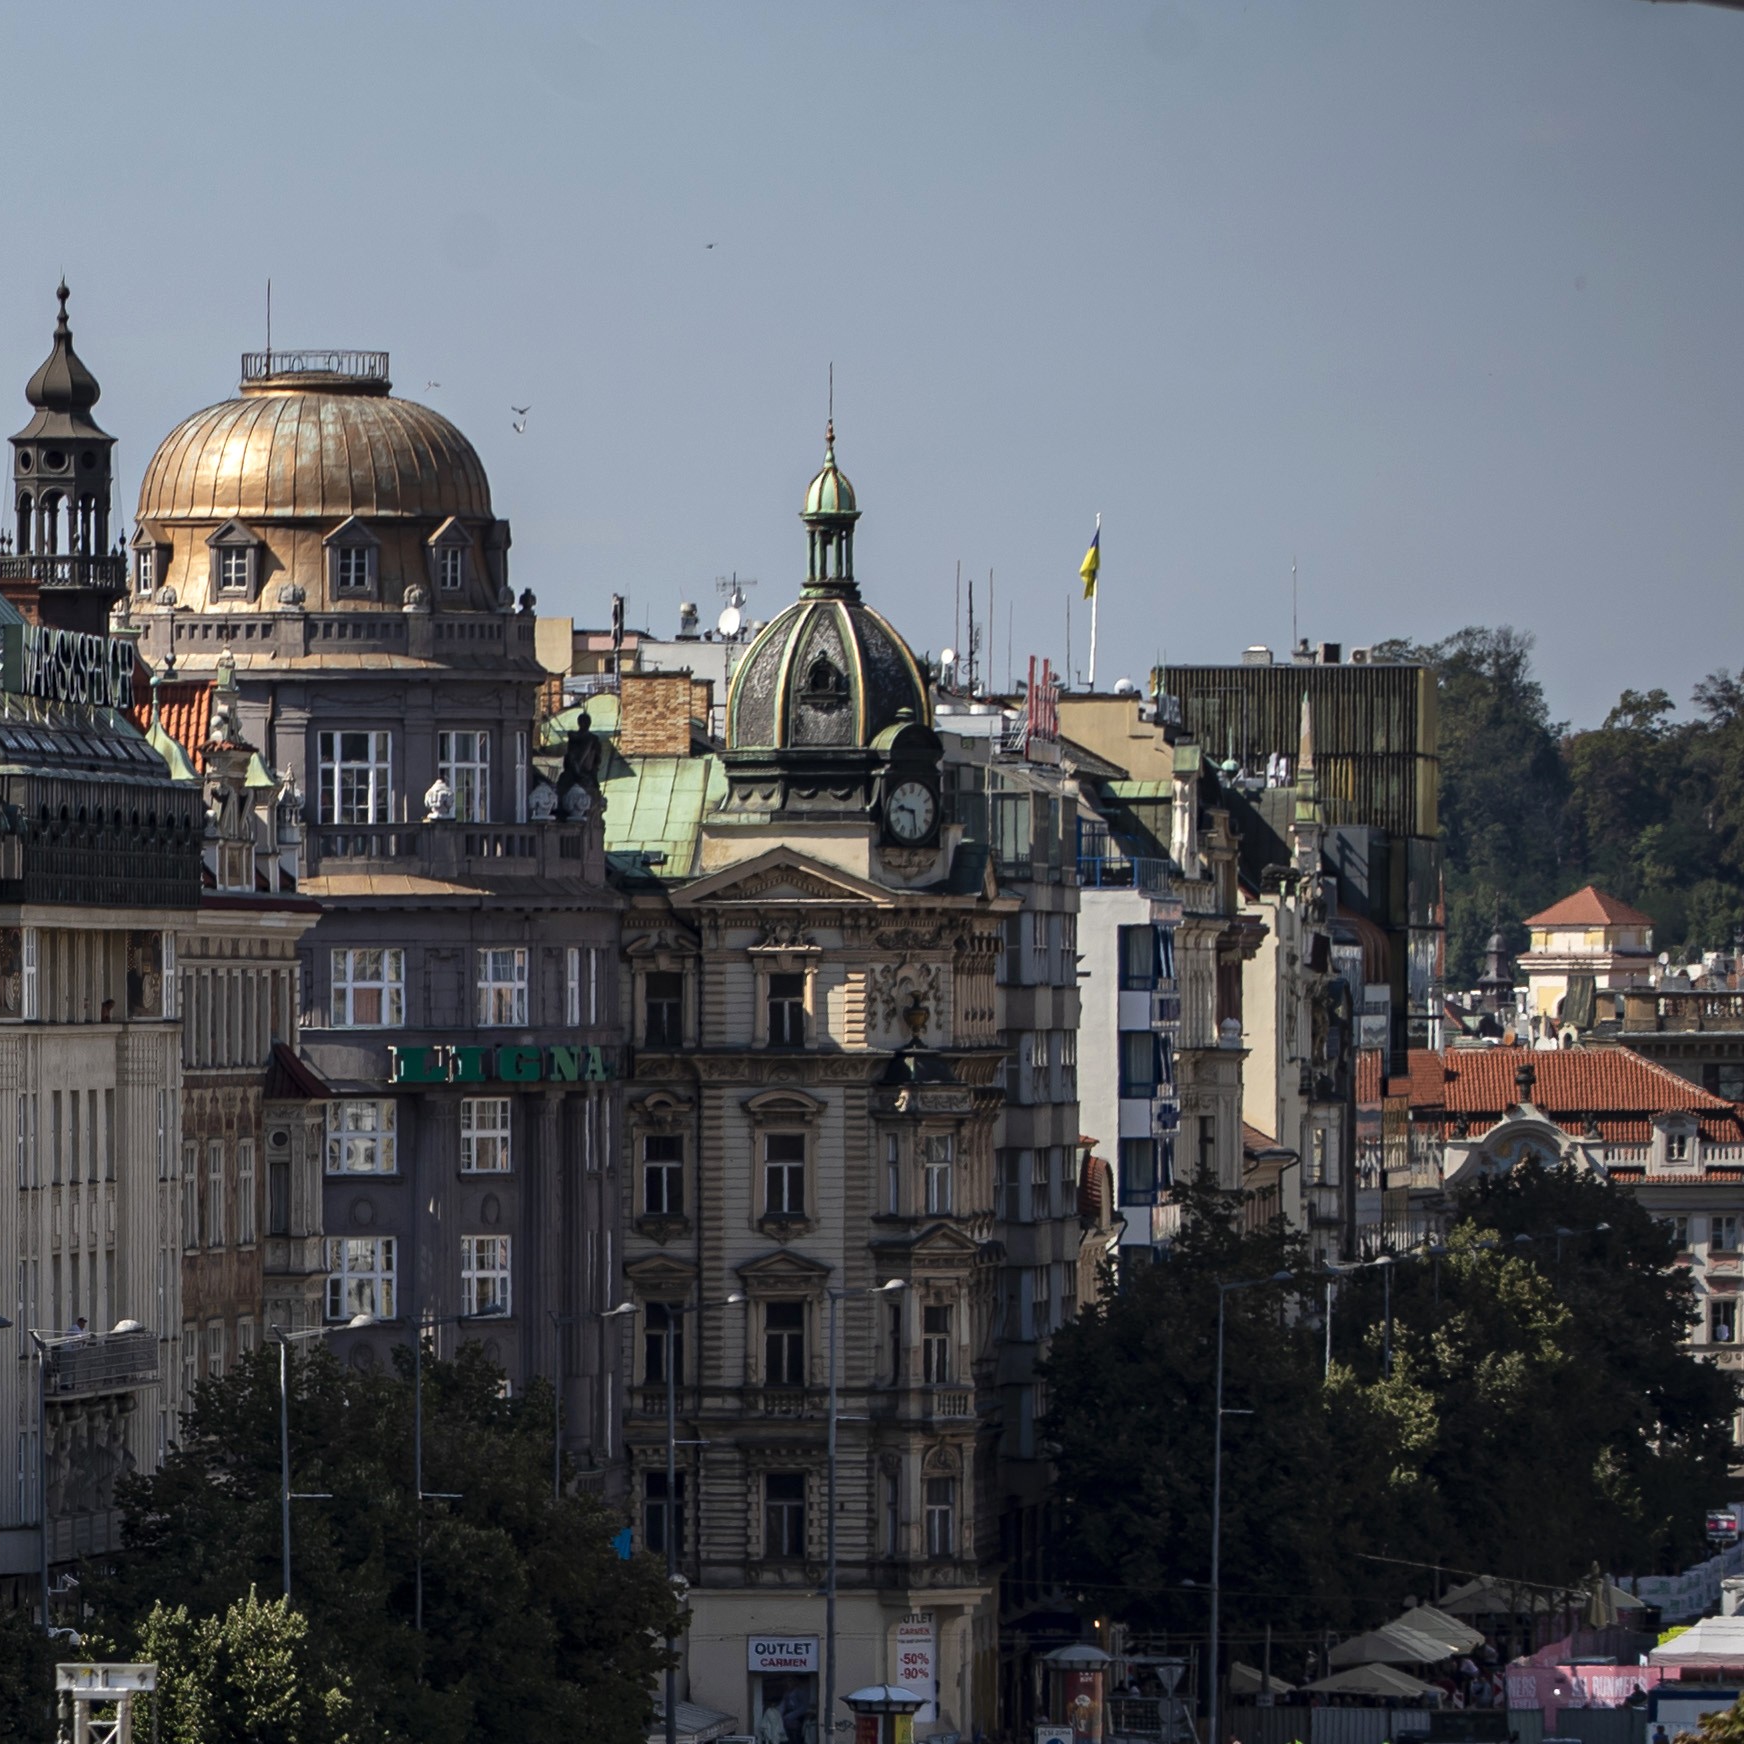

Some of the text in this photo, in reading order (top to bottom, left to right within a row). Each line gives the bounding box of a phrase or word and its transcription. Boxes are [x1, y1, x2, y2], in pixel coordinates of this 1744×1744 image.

[396, 1045, 607, 1082] LIGNA
[755, 1643, 812, 1656] OUTLET
[760, 1658, 807, 1668] CARMEN
[900, 1653, 930, 1665] -50%
[900, 1668, 930, 1680] -90%
